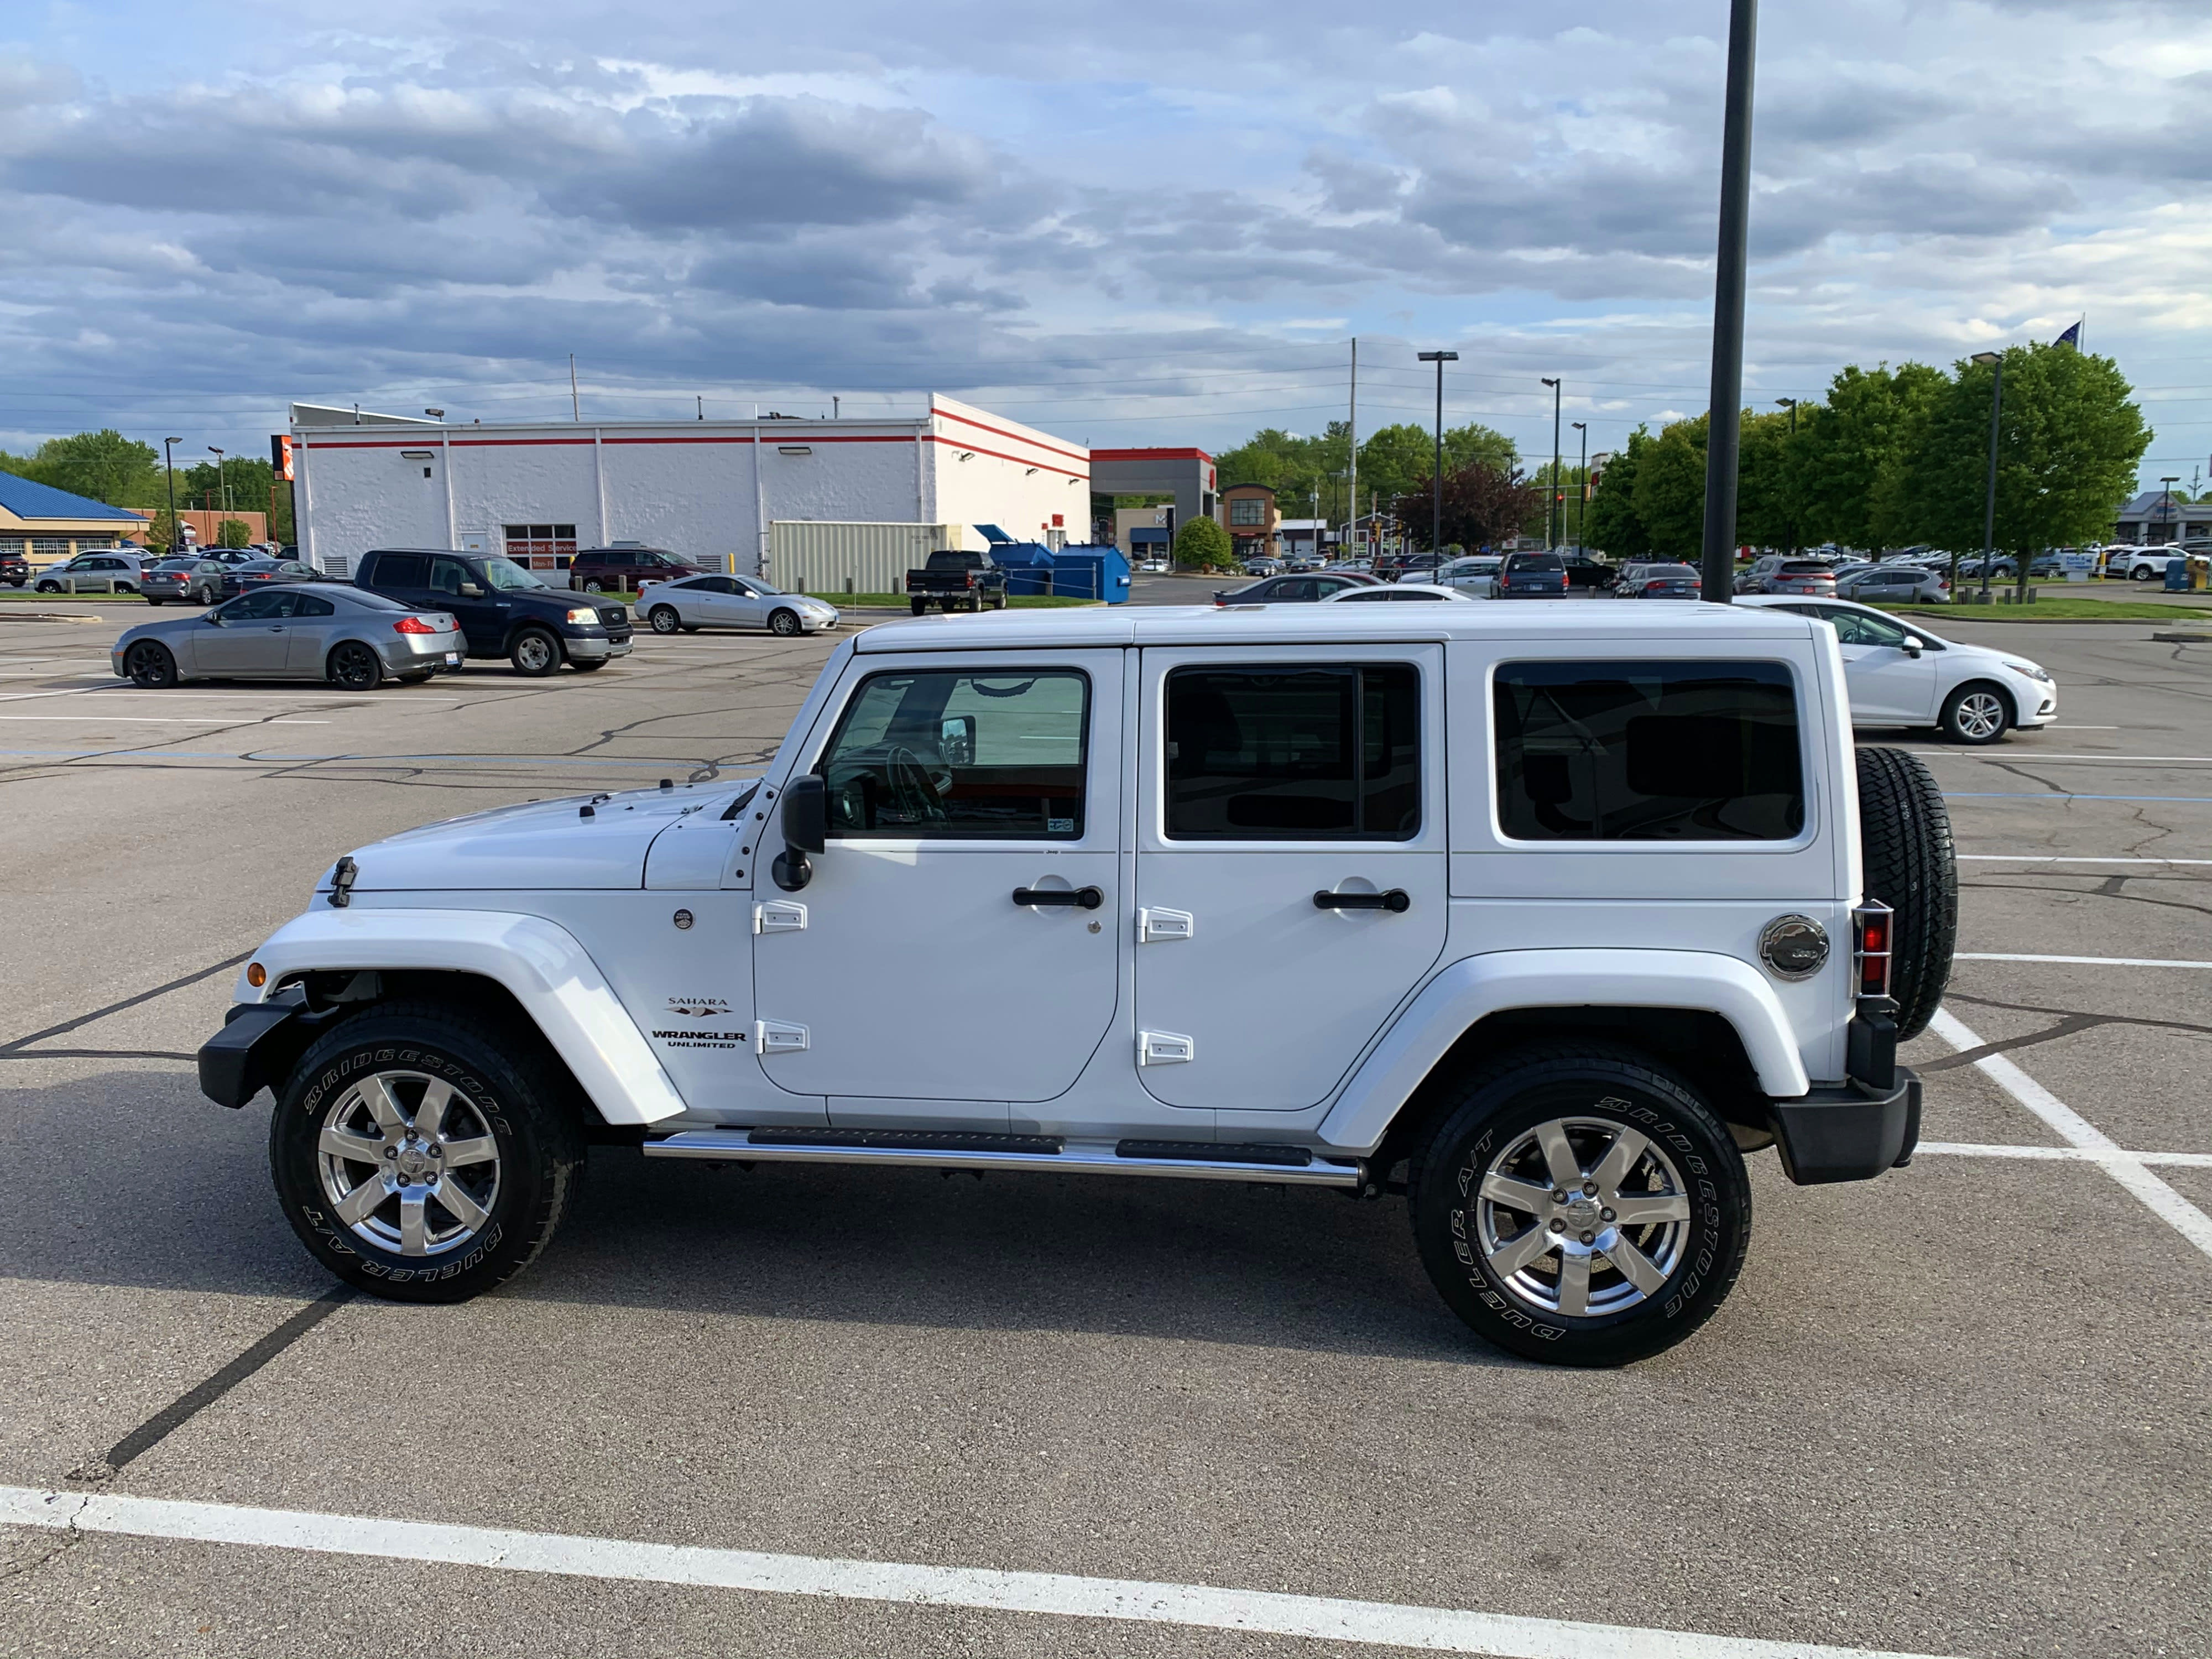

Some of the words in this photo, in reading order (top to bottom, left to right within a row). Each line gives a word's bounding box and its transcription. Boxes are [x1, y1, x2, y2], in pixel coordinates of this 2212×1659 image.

[1792, 948, 1818, 959] Jeep
[668, 997, 728, 1006] SAHARA
[652, 1031, 747, 1041] WRANGLER
[304, 1048, 513, 1136] BRIDGESTONE
[1457, 1128, 1494, 1198] A/T
[303, 1206, 356, 1254] A/T
[1594, 1095, 1719, 1319] BRIDGESTONE
[362, 1223, 503, 1283] DUELER
[1451, 1209, 1567, 1341] DUELER
